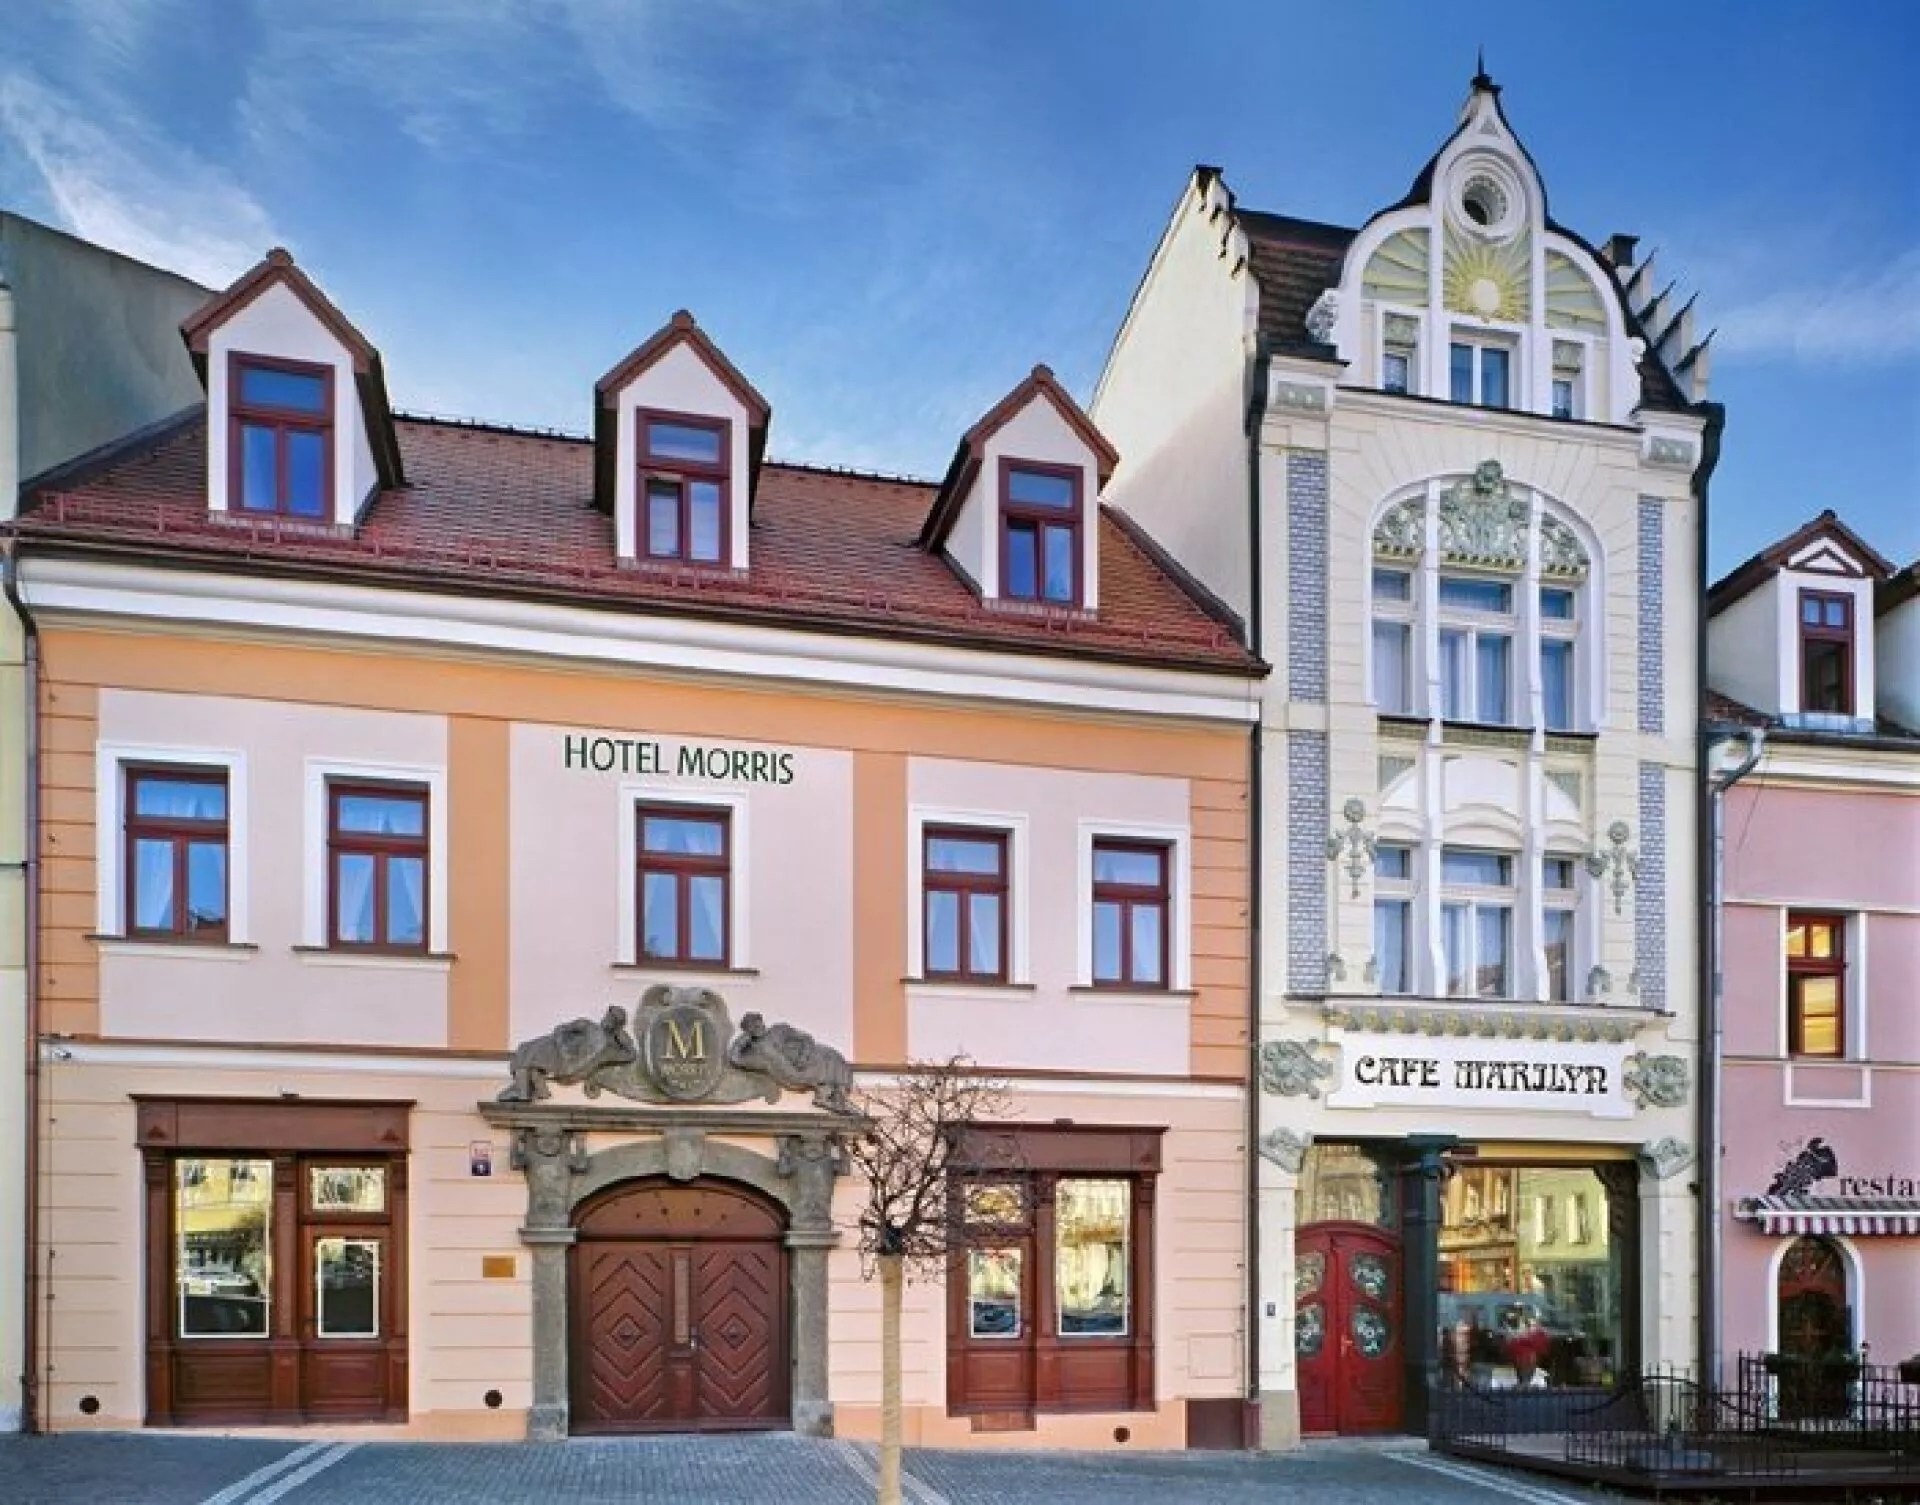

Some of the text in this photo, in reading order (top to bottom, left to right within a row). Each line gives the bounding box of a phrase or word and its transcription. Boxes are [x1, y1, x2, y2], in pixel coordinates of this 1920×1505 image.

[564, 734, 794, 784] HOTEL MORRIS
[660, 1019, 706, 1059] M
[1354, 1055, 1608, 1094] CAFE MARILYN
[1840, 1173, 1920, 1196] resta
